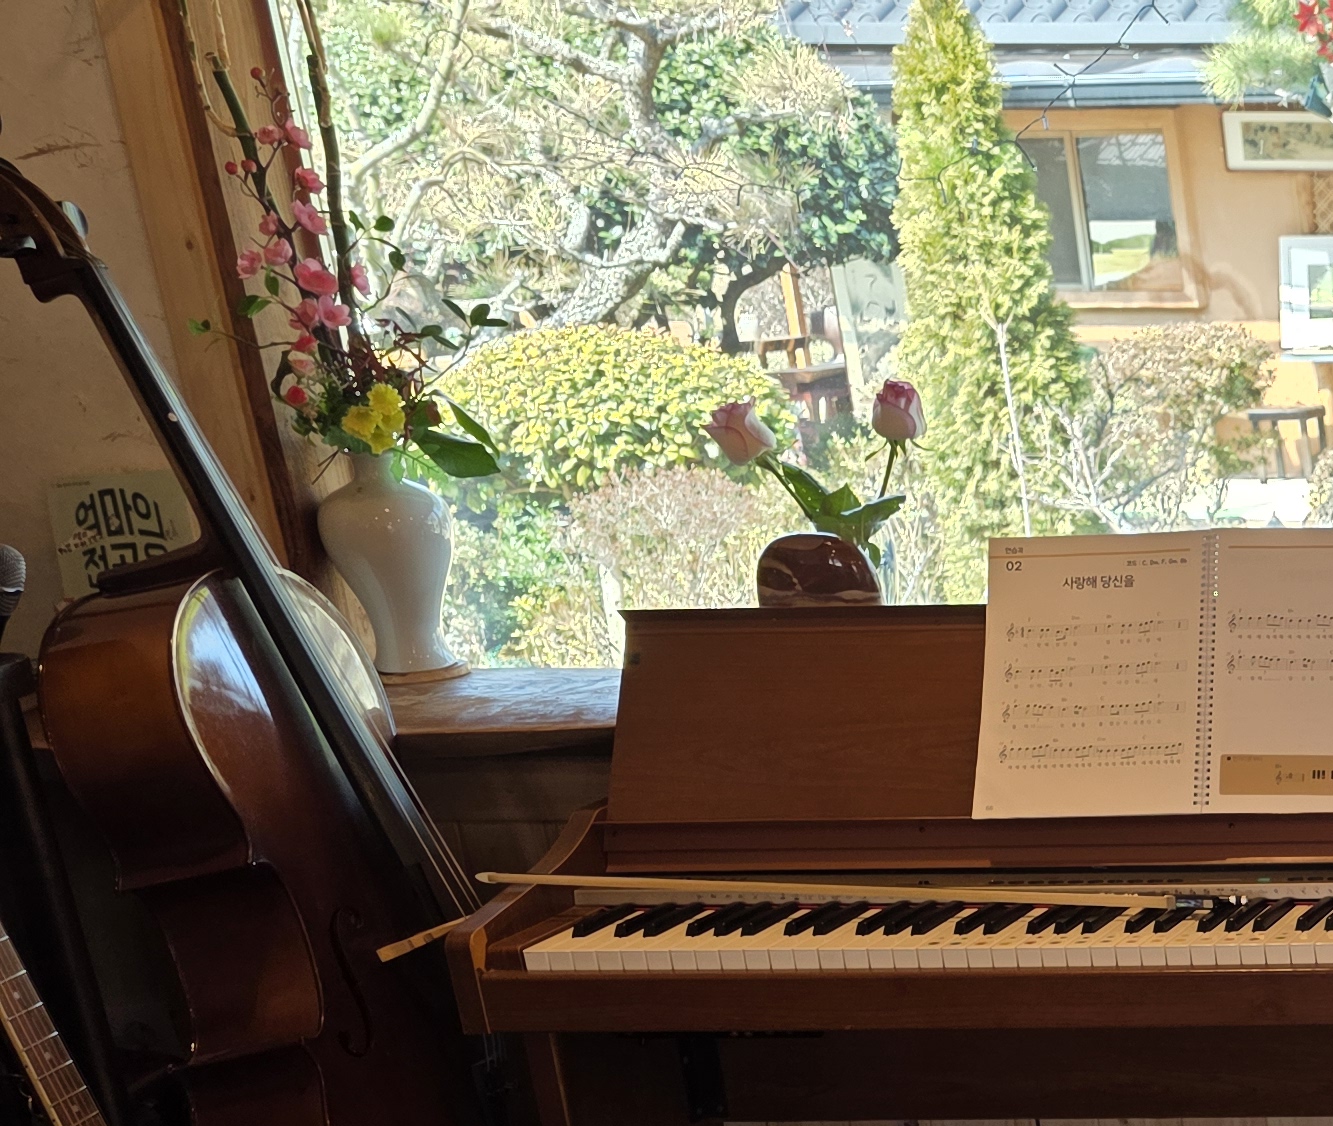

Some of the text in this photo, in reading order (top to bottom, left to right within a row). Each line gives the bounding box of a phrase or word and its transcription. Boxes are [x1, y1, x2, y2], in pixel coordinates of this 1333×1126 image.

[1006, 560, 1022, 572] 02
[1062, 574, 1135, 590] 사랑해 당신을
